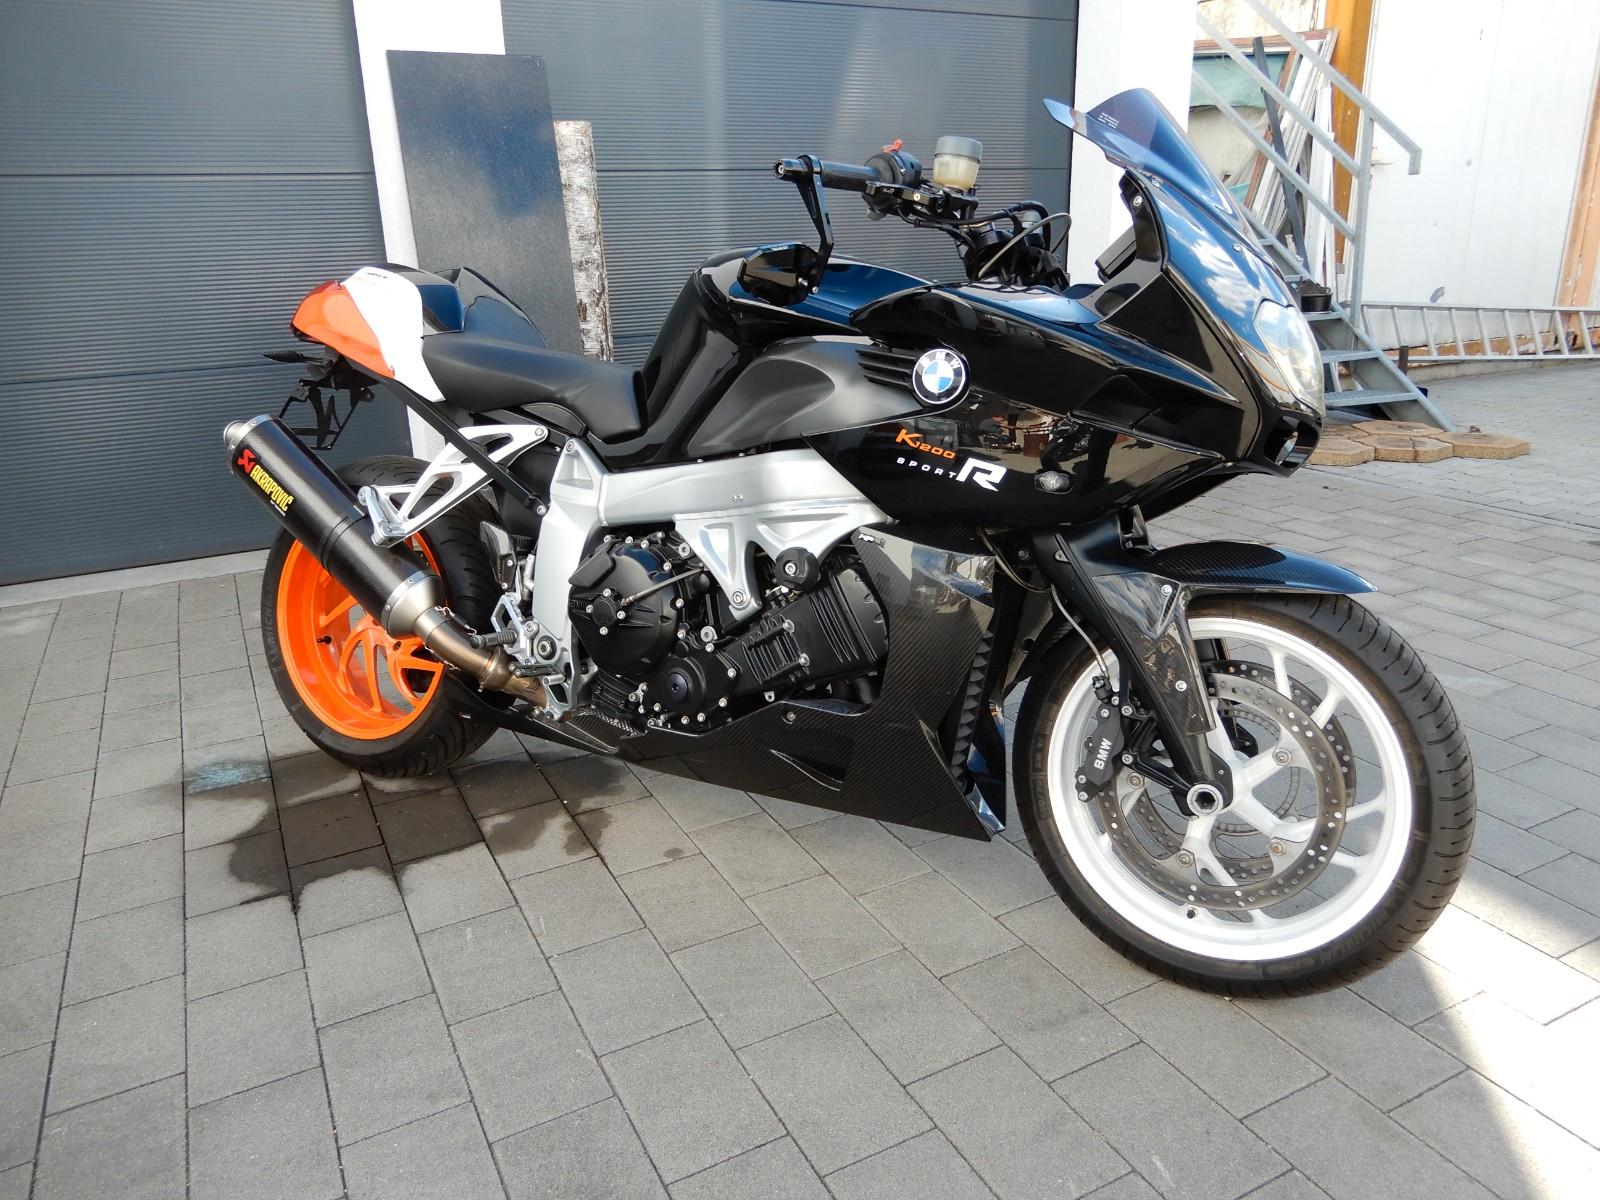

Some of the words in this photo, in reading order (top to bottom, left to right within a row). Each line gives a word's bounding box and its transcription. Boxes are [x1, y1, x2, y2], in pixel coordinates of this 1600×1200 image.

[919, 351, 961, 369] BMW
[895, 429, 957, 460] K1200
[896, 457, 957, 479] SPORT
[955, 457, 1007, 492] R
[1093, 737, 1112, 770] BMW
